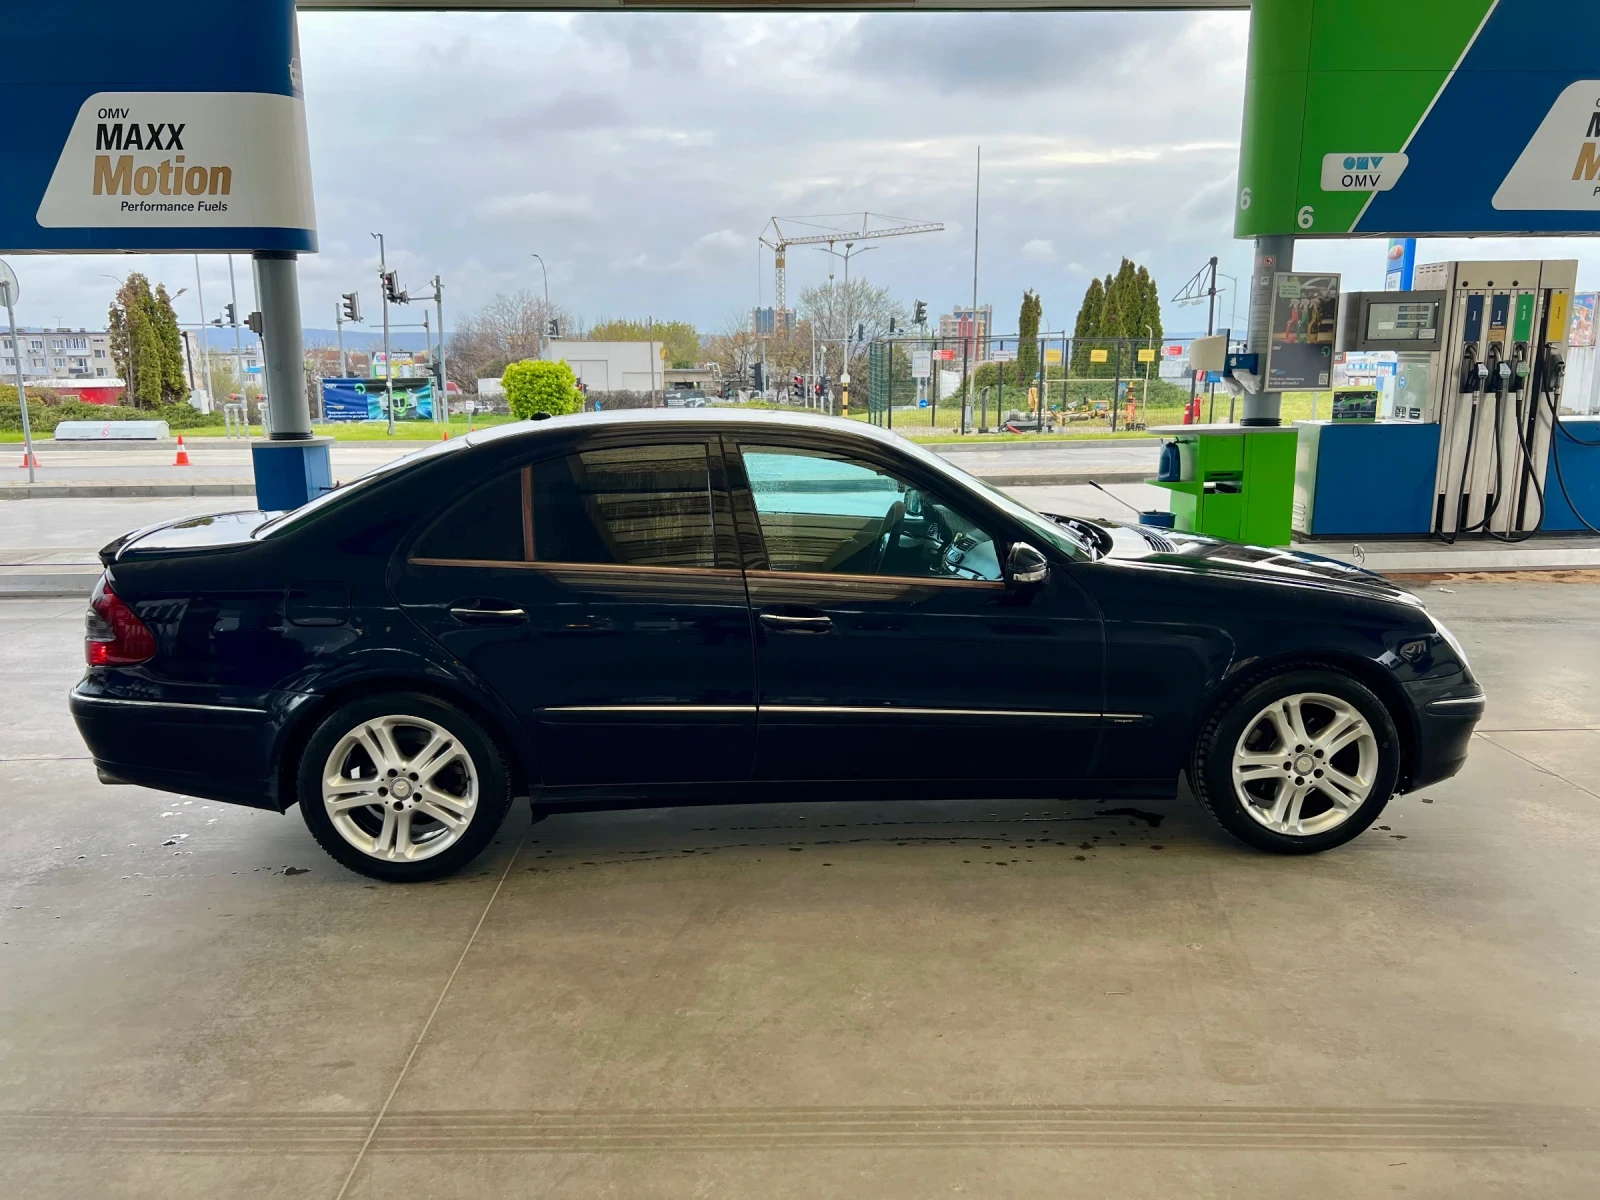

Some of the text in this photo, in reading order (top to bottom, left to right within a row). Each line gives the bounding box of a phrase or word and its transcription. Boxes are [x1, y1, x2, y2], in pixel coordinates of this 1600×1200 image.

[97, 108, 130, 119] OMV
[95, 123, 186, 151] MAXX
[92, 155, 232, 196] Motion
[1341, 174, 1381, 188] OMV
[120, 200, 228, 213] Performance Fuels
[1239, 187, 1251, 210] 6
[1297, 205, 1314, 229] 6
